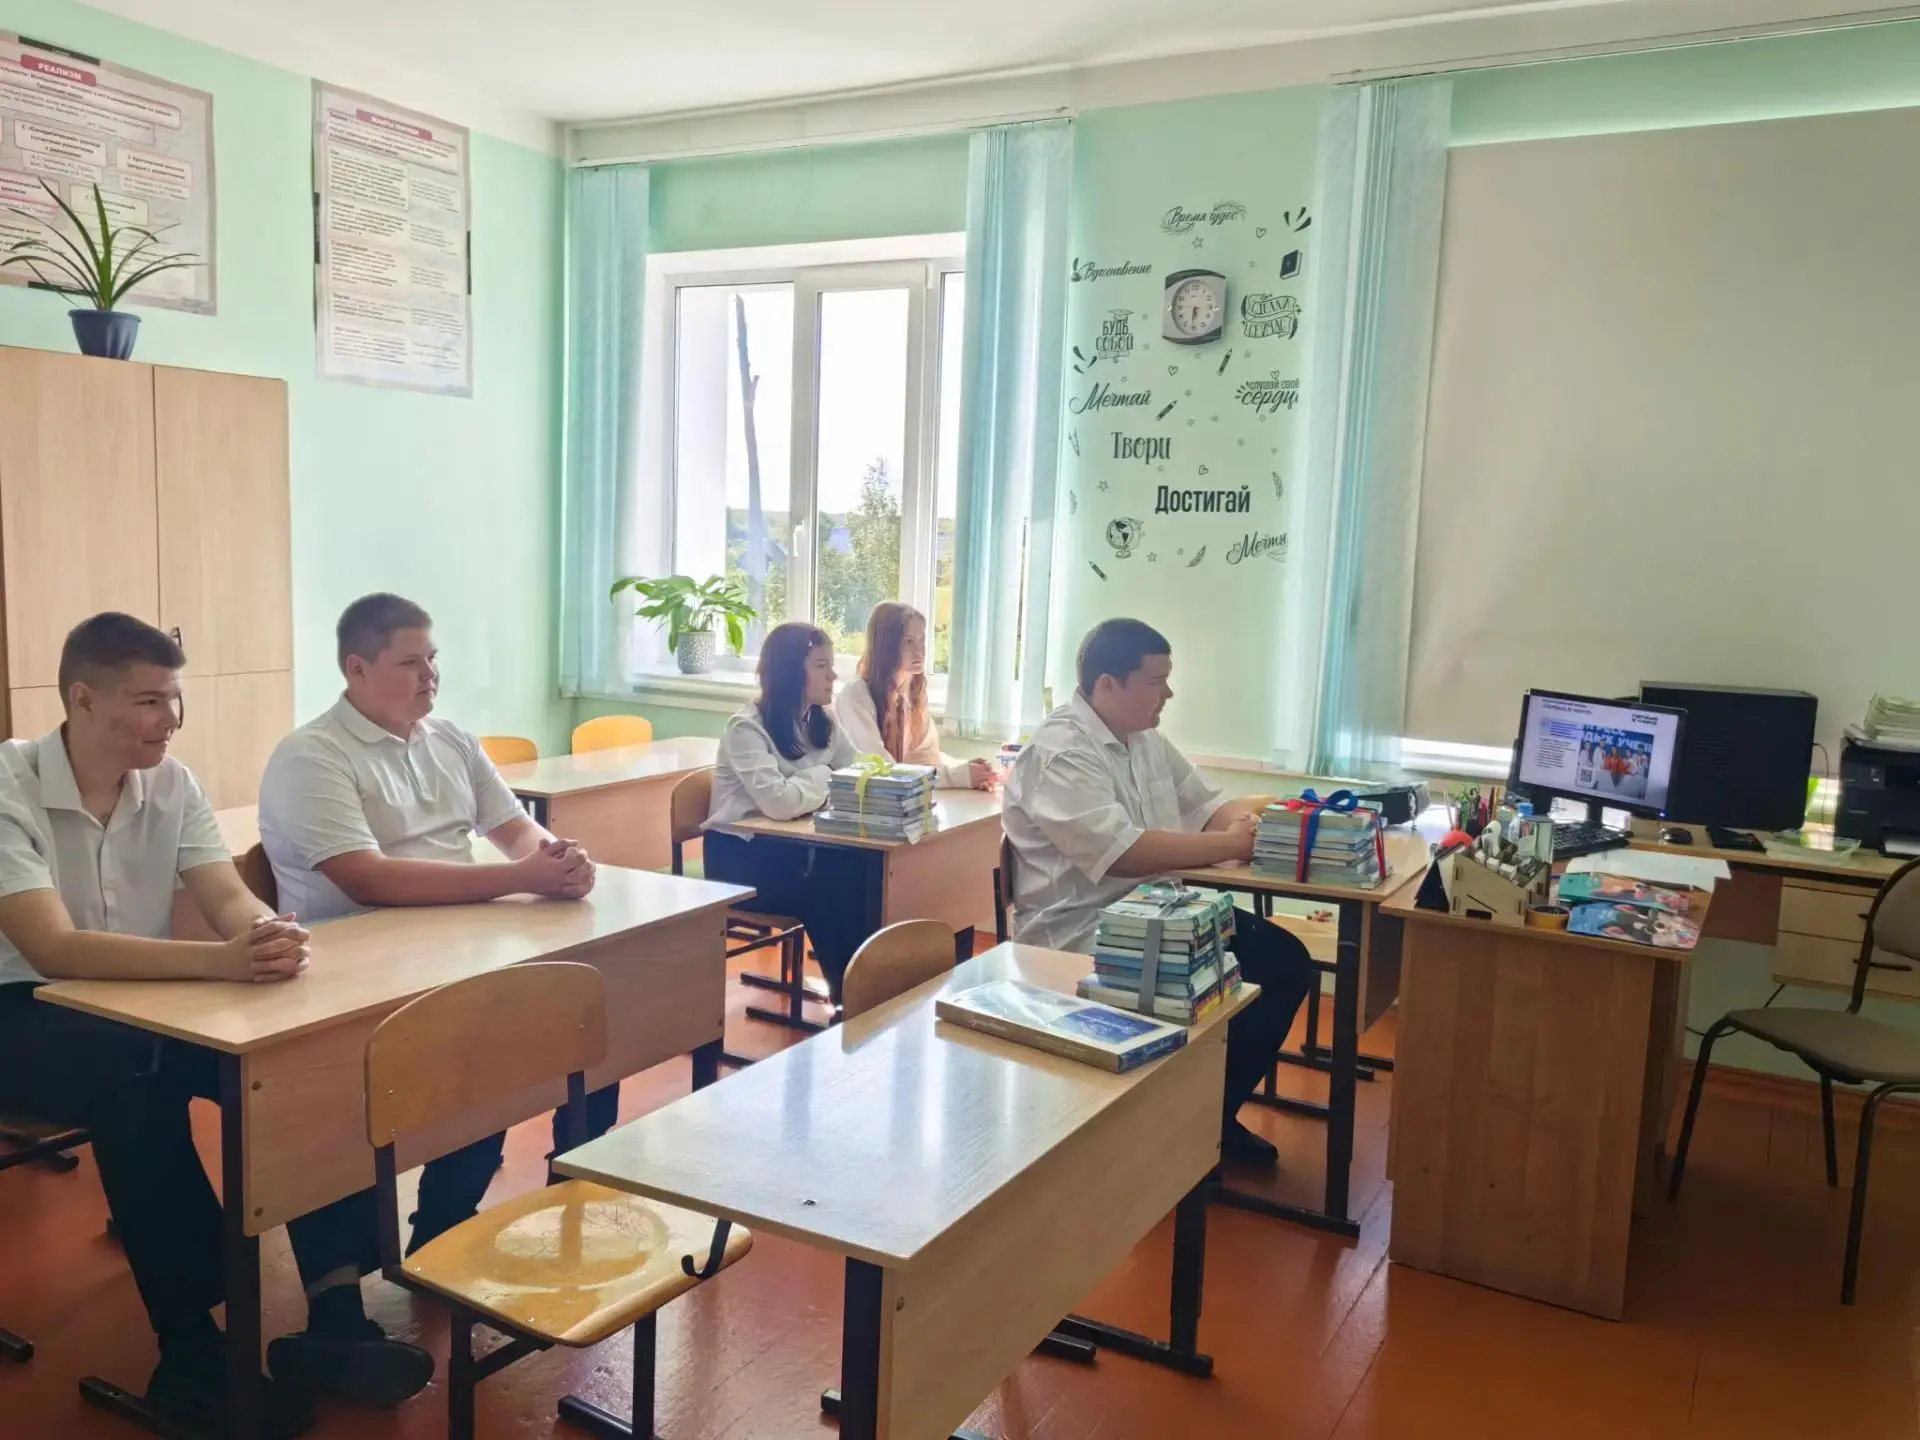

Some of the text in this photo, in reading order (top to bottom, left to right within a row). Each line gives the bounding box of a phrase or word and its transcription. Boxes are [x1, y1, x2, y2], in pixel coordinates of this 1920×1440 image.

[37, 62, 82, 81] РЕАЛИЗМ
[1165, 205, 1238, 227] Время чудес
[1078, 260, 1152, 282] Вдохновение
[1102, 320, 1129, 336] БУДЬ
[1095, 333, 1134, 351] СОБОЙ
[1069, 382, 1151, 414] Мечтай
[1111, 432, 1171, 465] Твори
[1155, 485, 1250, 515] Достигай
